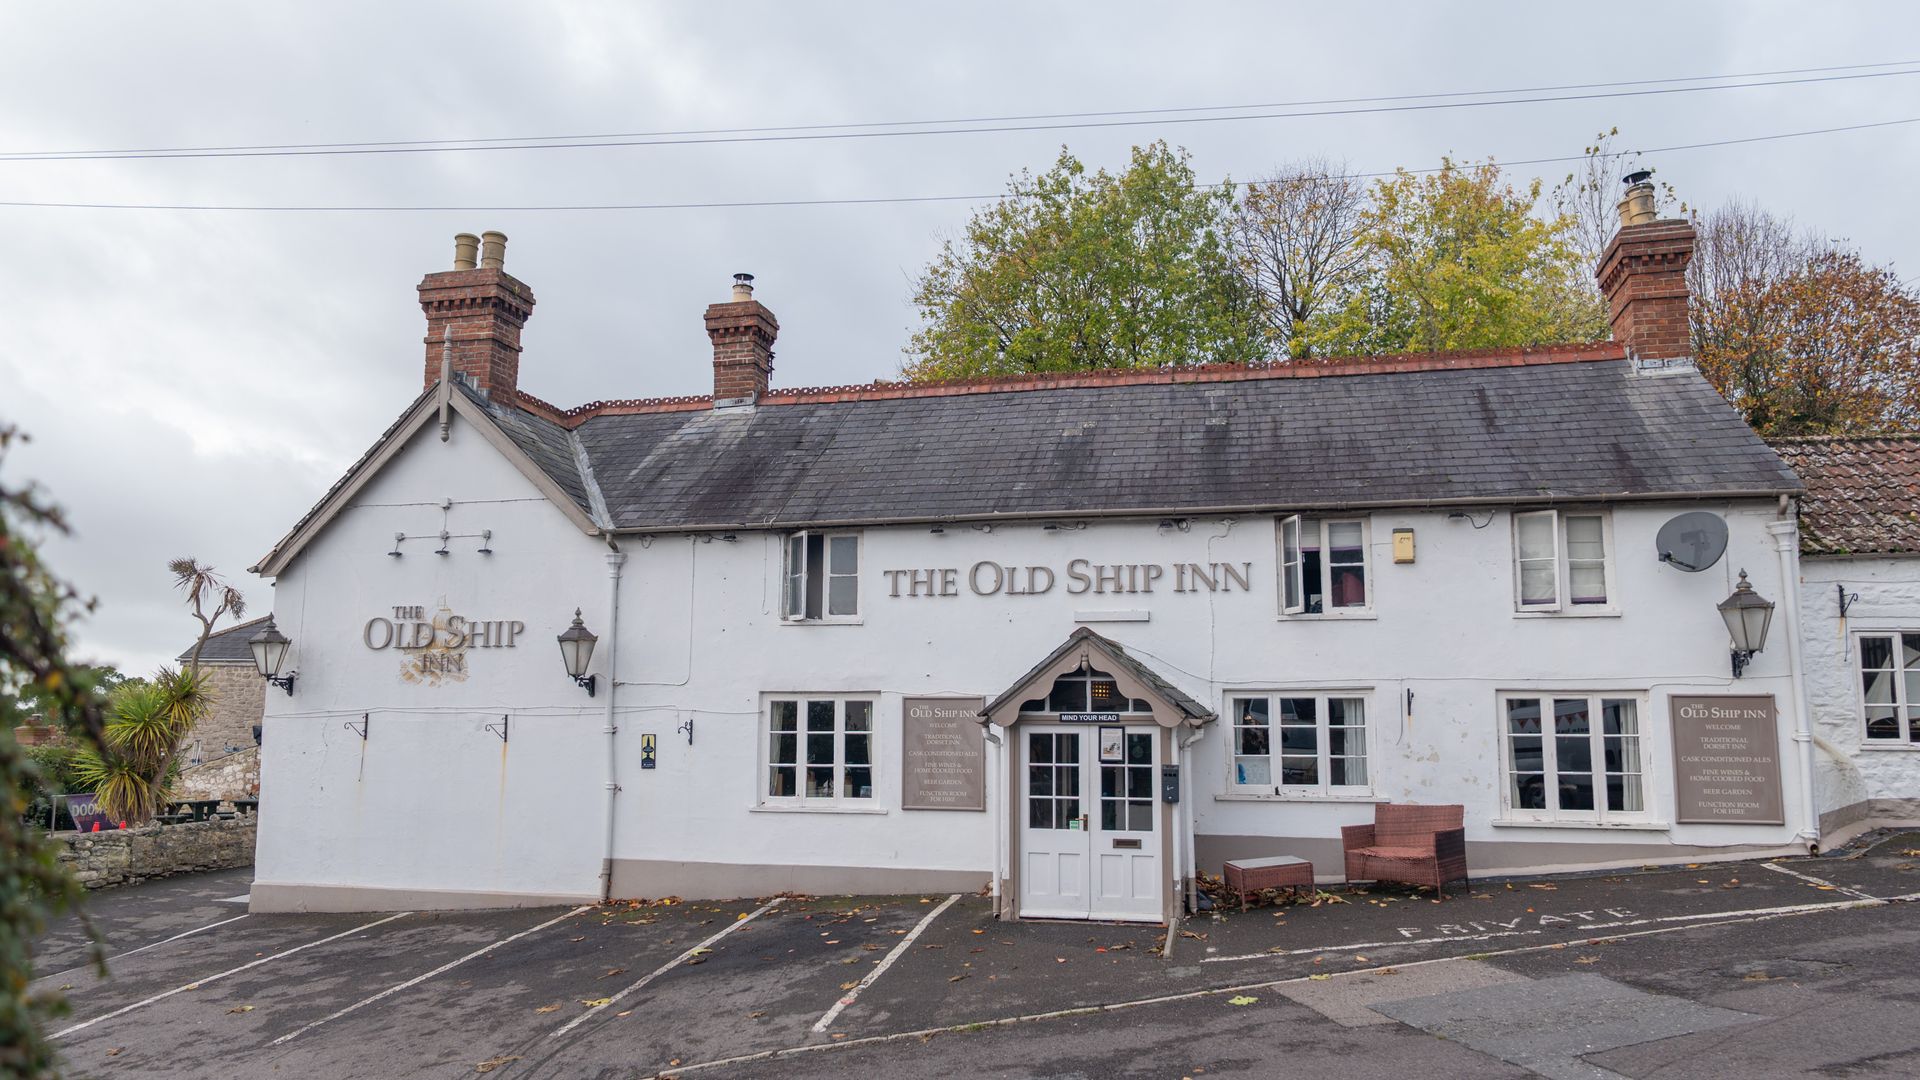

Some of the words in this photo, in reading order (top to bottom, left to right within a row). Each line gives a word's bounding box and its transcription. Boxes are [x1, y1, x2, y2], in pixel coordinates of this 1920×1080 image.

[884, 568, 958, 597] THE
[968, 560, 1055, 597] OLD
[1066, 558, 1163, 595] SHIP
[1173, 562, 1252, 593] INN
[392, 605, 424, 619] THE
[364, 617, 435, 650] OLD
[444, 615, 525, 649] SHIP
[421, 653, 464, 673] INN
[910, 707, 932, 718] OLD
[934, 707, 958, 718] SHIP
[960, 710, 977, 718] INN
[1680, 706, 1709, 718] OLD
[1711, 706, 1741, 719] SHIP
[1743, 710, 1767, 718] INN
[1397, 907, 1639, 938] PRIVATE
